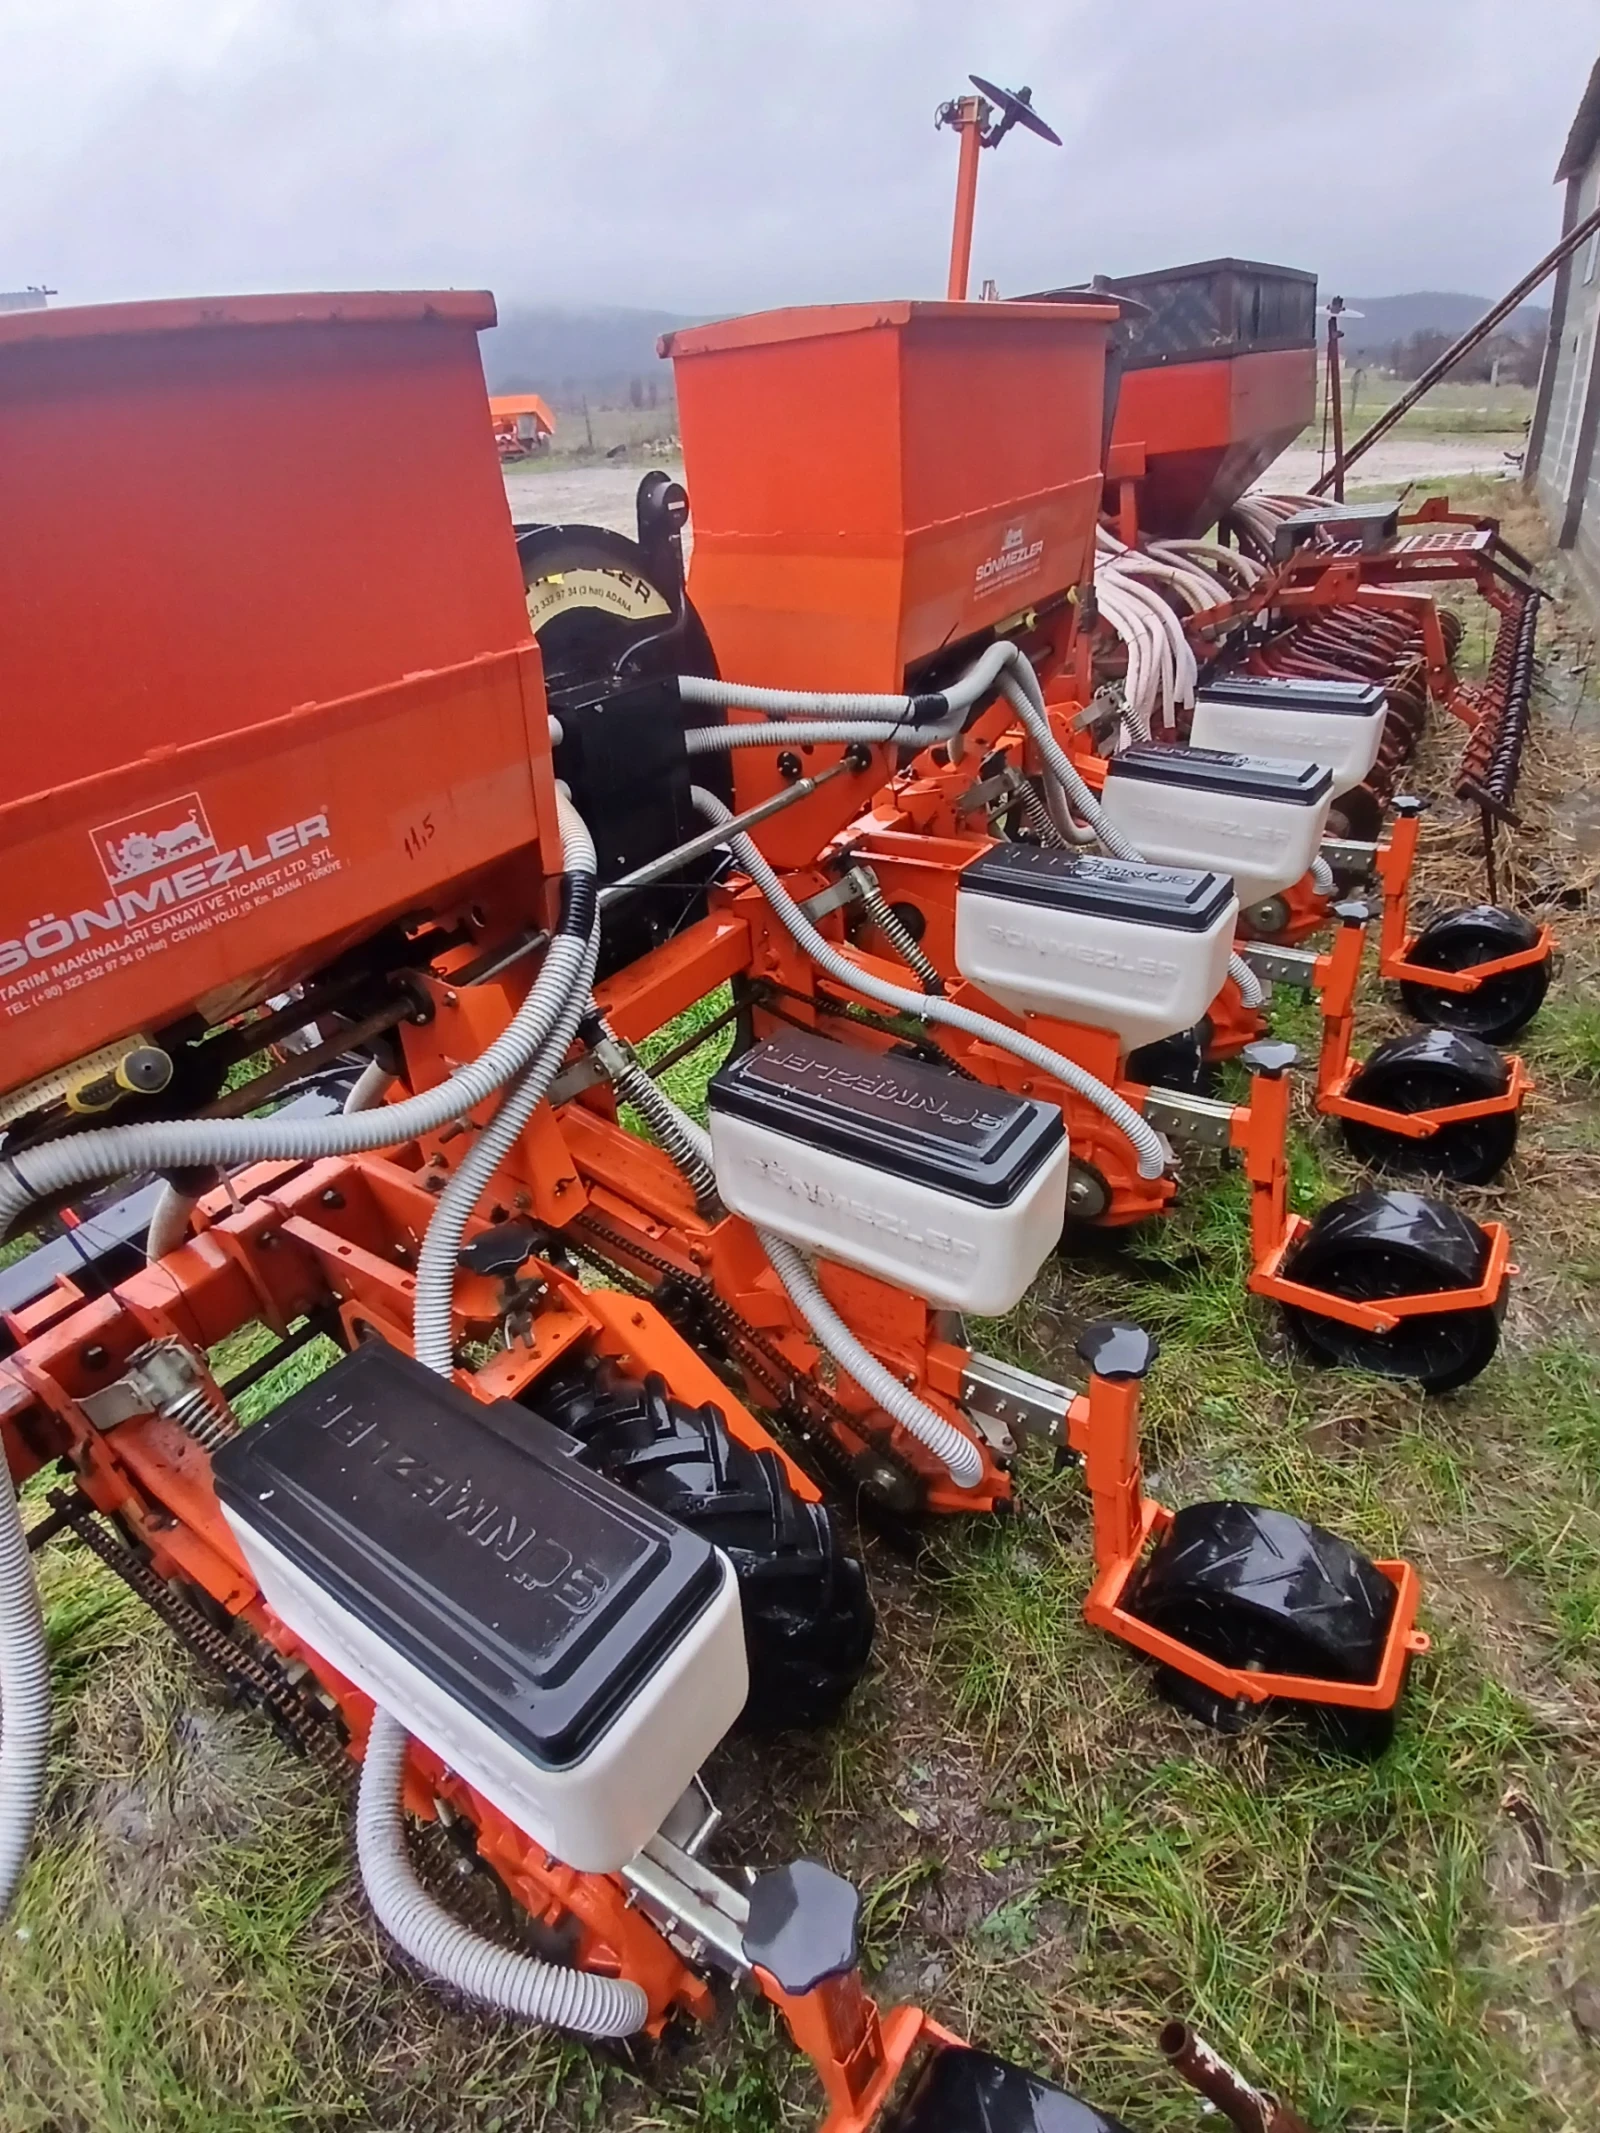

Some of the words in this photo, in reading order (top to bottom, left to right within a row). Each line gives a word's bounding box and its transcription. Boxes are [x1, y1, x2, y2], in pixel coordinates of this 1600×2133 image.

[529, 605, 540, 618] 22
[540, 595, 554, 609] 332
[556, 590, 565, 601] 97
[568, 586, 577, 597] 34
[605, 591, 632, 613] ADANA
[975, 540, 1044, 581] SÖNMEZLER
[0, 814, 330, 976] SÖNMEZLER
[0, 970, 49, 1001] TARIM
[51, 929, 149, 978] MAKİNALARI
[151, 899, 204, 935] SANAYİ
[206, 894, 226, 911] VE
[226, 870, 281, 903] TİCARET
[63, 974, 84, 991] 322
[86, 965, 105, 982] 332
[105, 959, 118, 972] 97
[119, 952, 133, 966] 34
[171, 917, 213, 943] CEYHAN
[212, 906, 239, 924] YOLU
[272, 878, 302, 899] ADANA
